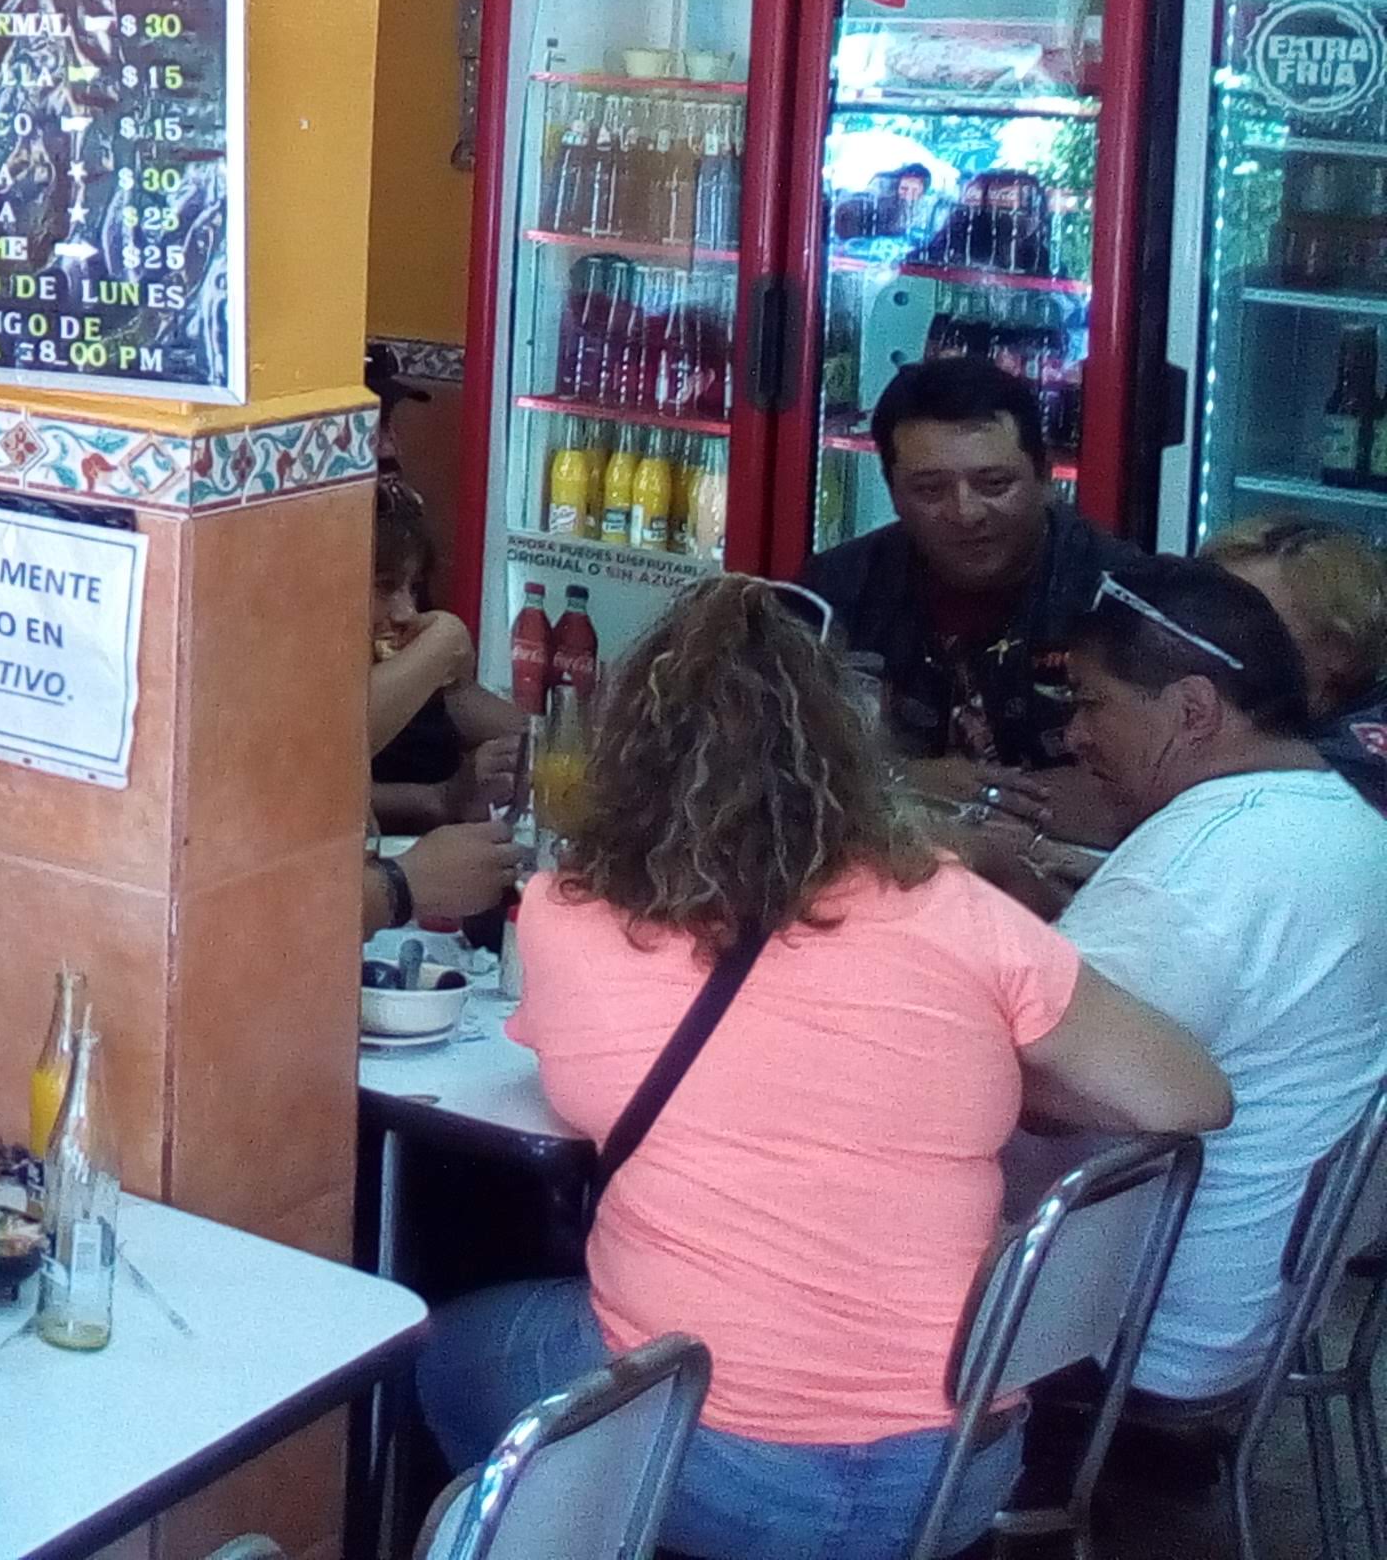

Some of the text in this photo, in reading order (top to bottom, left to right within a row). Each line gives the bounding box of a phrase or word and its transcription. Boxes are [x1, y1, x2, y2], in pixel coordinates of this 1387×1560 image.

[145, 13, 182, 37] 30
[1268, 35, 1369, 62] EXTRA
[148, 64, 184, 89] 15
[153, 114, 182, 139] 15
[143, 168, 181, 192] 30
[15, 276, 57, 300] DE
[82, 281, 185, 309] LUNES
[60, 315, 102, 340] DE
[119, 344, 163, 372] PM
[507, 548, 582, 574] ORIGINAL
[26, 618, 63, 648] EN
